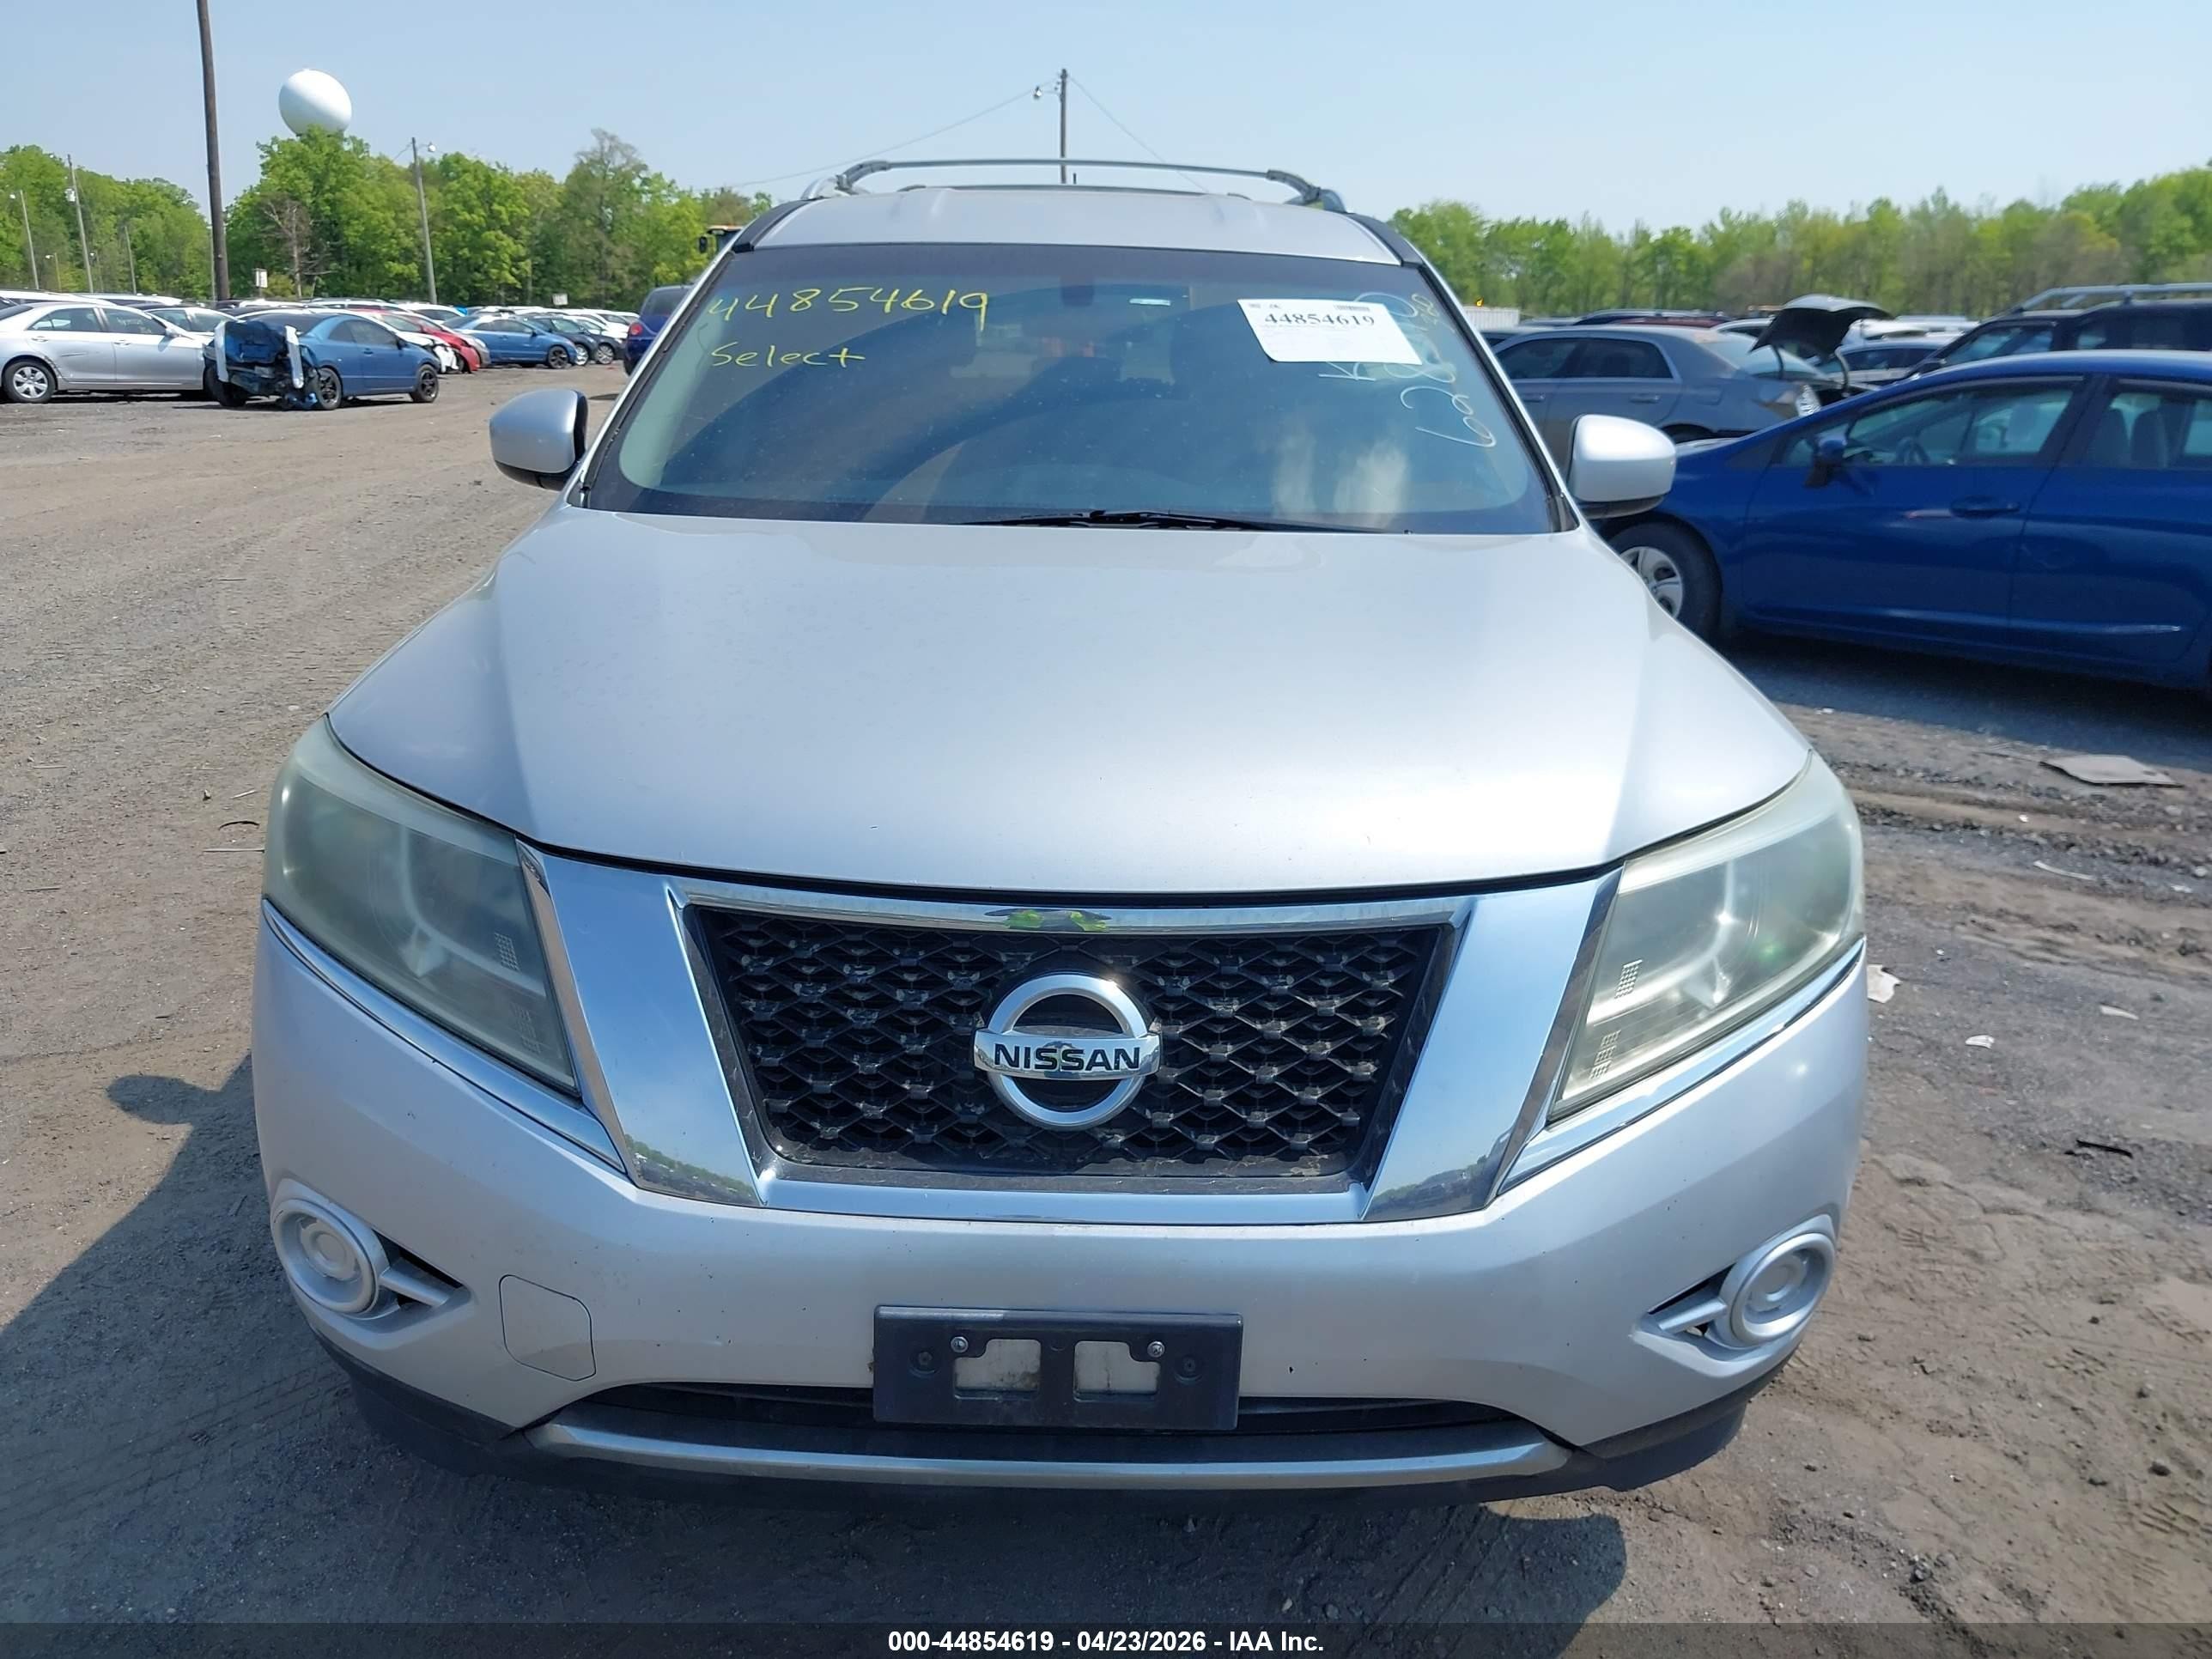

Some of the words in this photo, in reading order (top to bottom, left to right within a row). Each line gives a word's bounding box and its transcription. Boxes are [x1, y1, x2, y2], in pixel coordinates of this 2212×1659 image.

[709, 287, 989, 331] 44854619
[1264, 312, 1376, 327] 44854619
[710, 341, 866, 368] Select
[994, 1042, 1141, 1072] NISSAN
